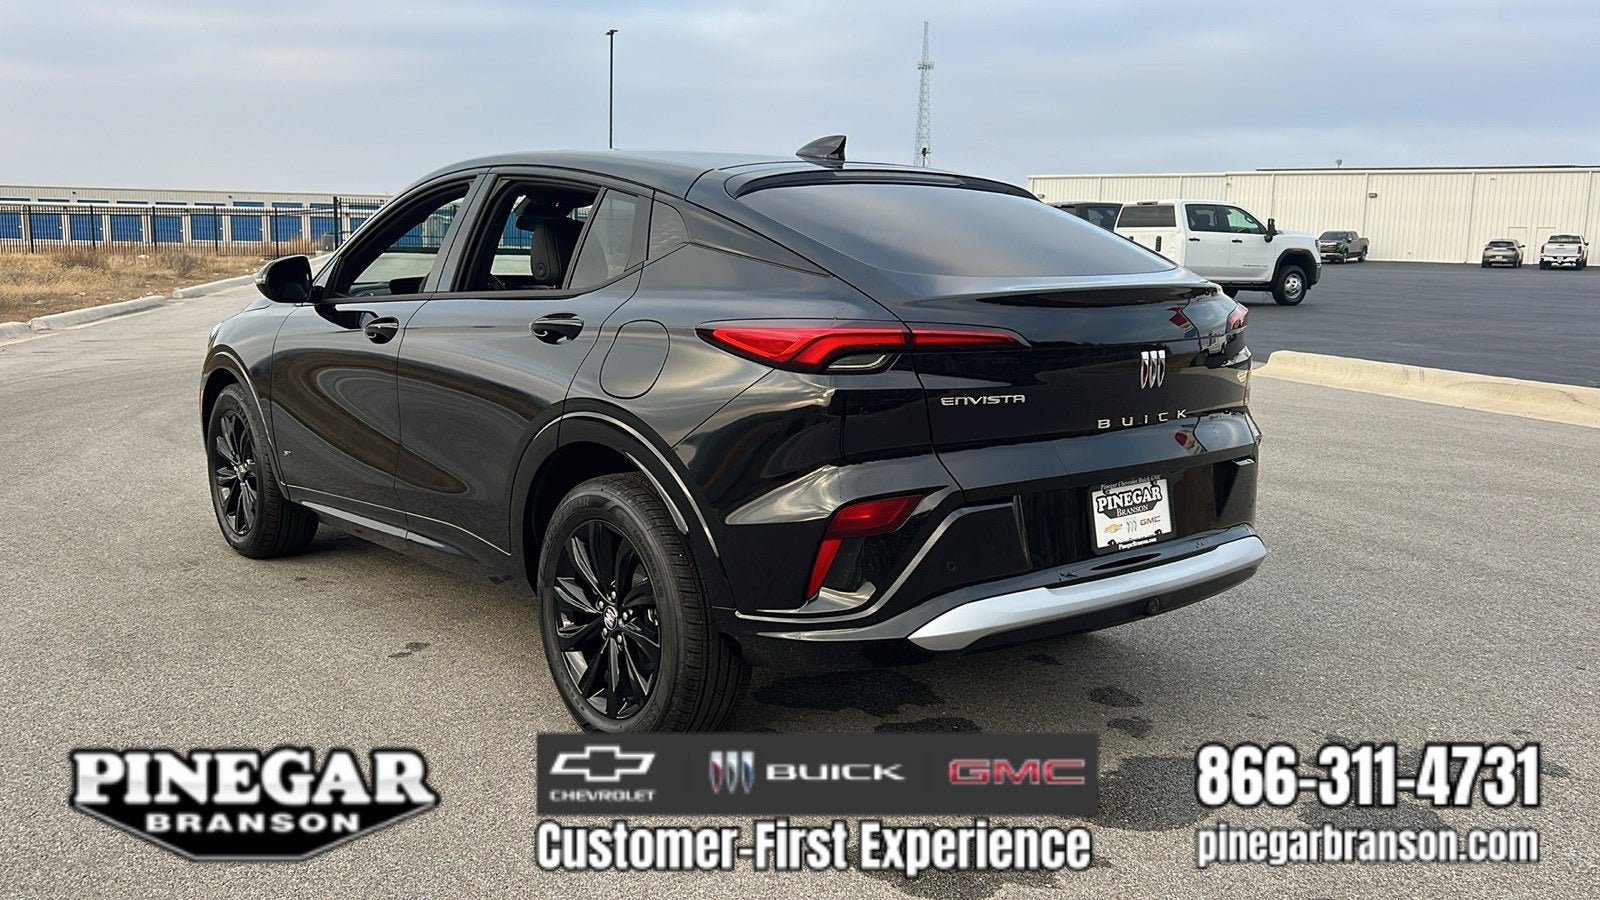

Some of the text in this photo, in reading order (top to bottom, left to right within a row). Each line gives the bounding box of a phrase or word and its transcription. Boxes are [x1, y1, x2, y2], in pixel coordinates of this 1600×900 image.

[940, 394, 1026, 406] ENVISTA
[1097, 408, 1188, 430] BUICK
[1097, 486, 1161, 512] PINEGAR
[1116, 504, 1149, 517] BRANSON
[1140, 516, 1161, 526] GMC
